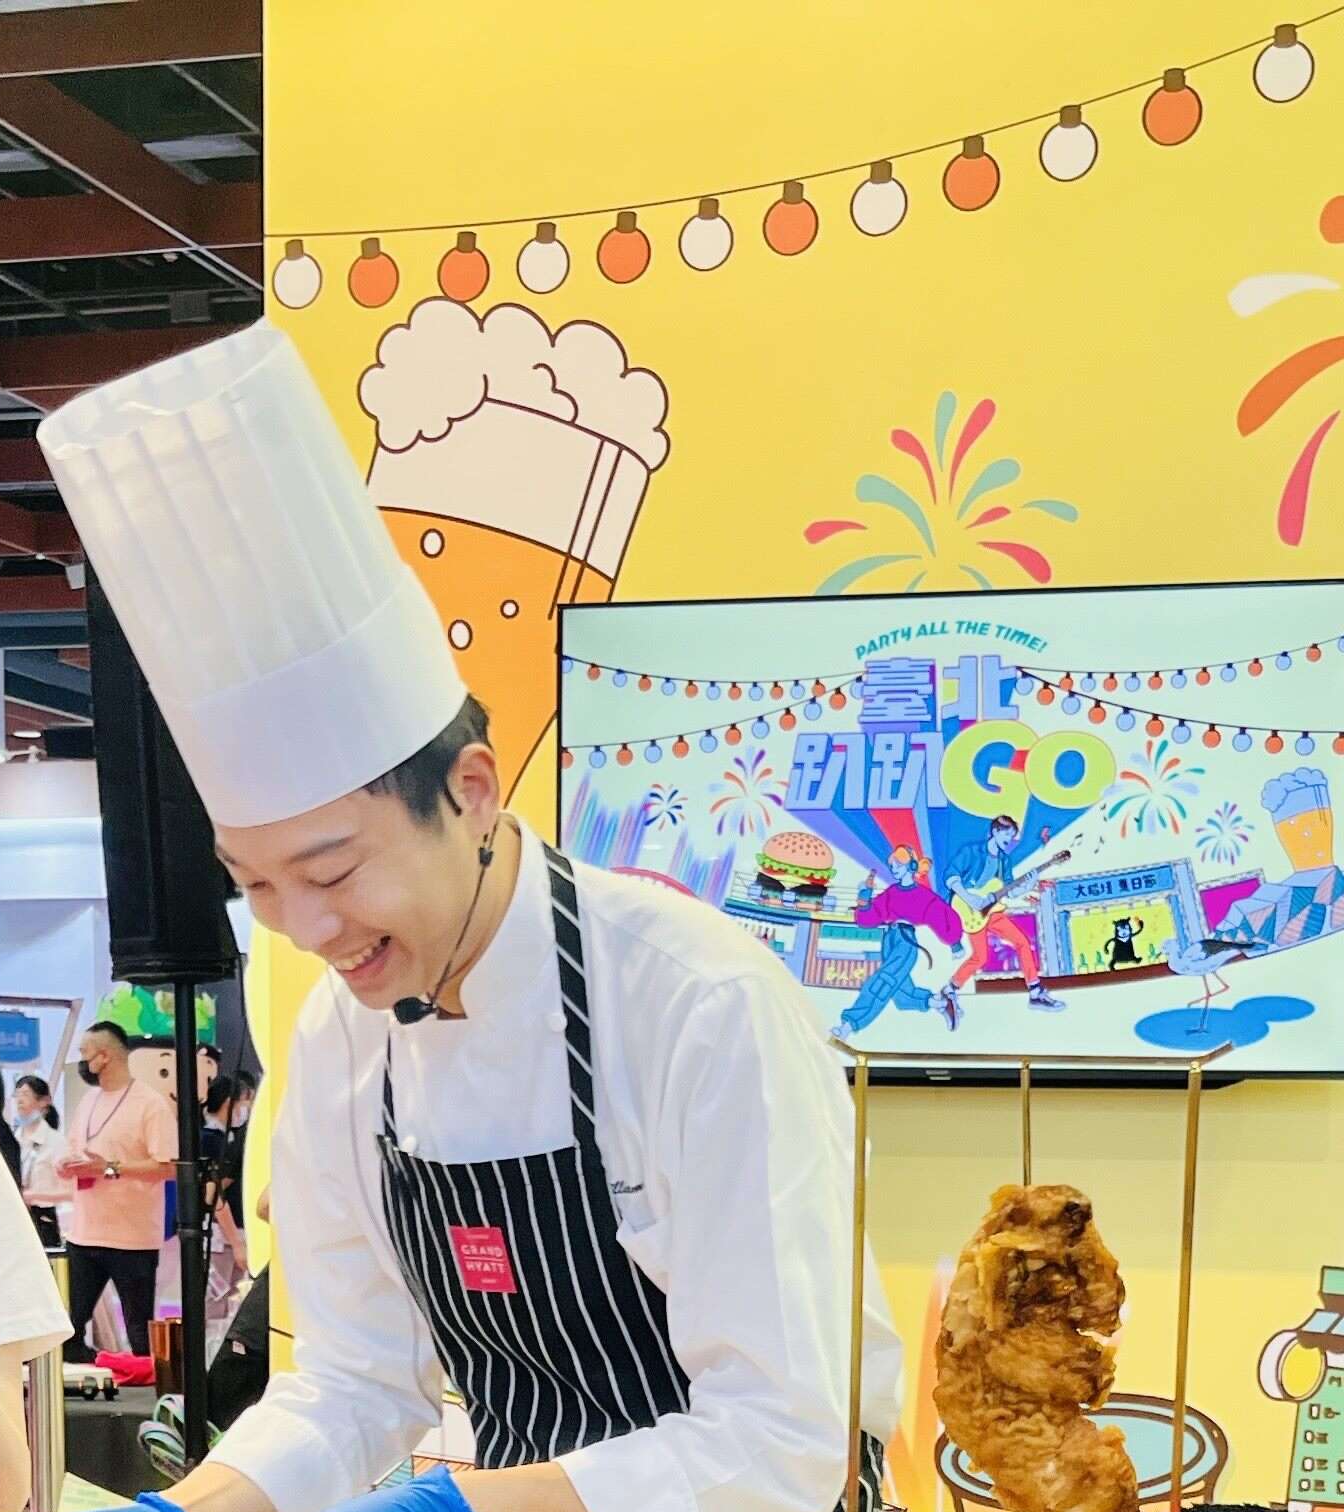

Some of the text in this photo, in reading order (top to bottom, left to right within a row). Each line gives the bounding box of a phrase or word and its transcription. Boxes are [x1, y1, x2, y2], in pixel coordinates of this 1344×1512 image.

[855, 620, 1048, 660] PARTY ALL THE TIME!
[858, 654, 1020, 724] 臺北
[460, 1244, 504, 1258] GRAND
[466, 1261, 506, 1275] HYATT
